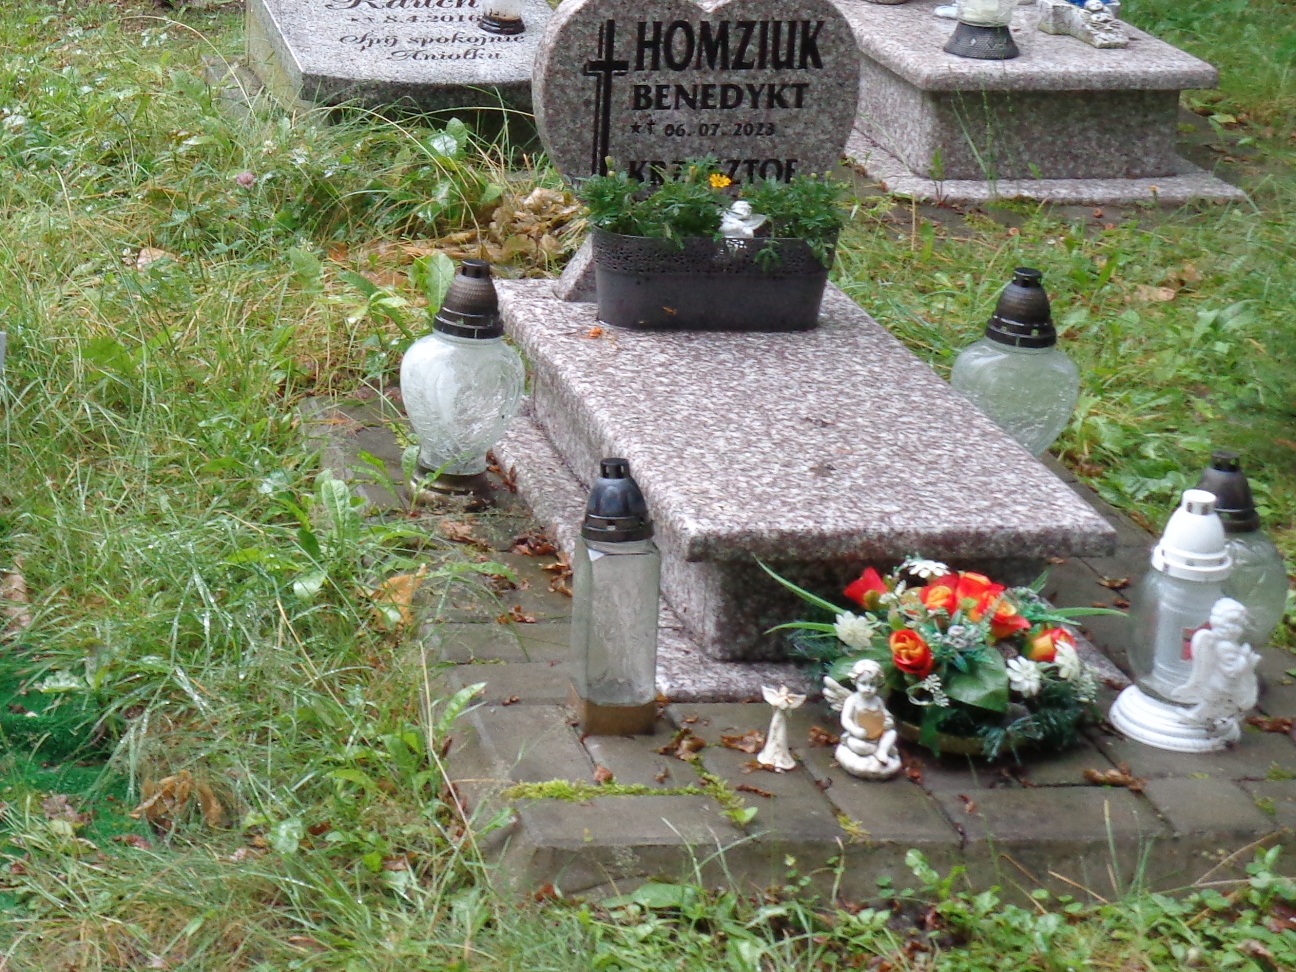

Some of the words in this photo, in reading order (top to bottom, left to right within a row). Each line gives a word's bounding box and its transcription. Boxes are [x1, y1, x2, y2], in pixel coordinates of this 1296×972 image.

[406, 30, 526, 48] spokojnie
[633, 19, 826, 72] HOMZIUK
[632, 82, 810, 111] BENEDYKT
[733, 122, 776, 137] 2023
